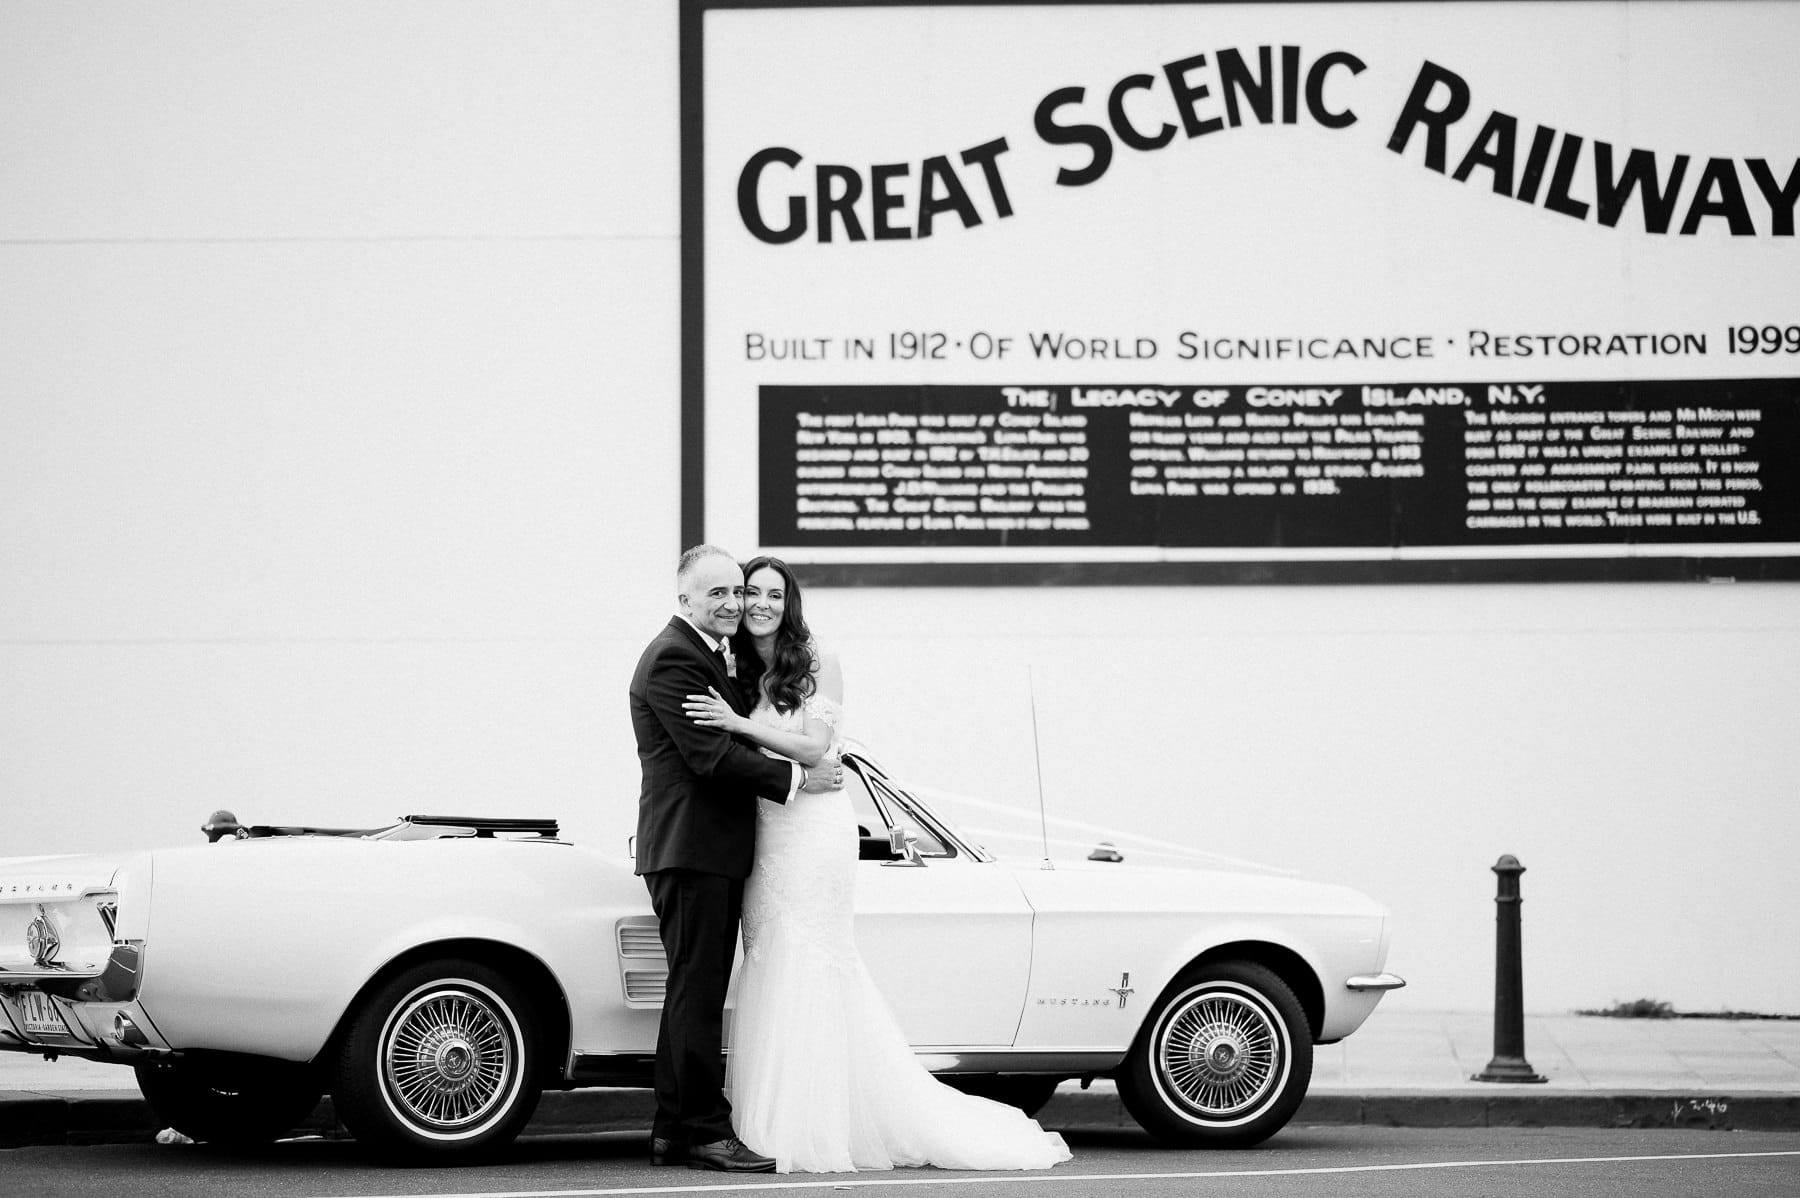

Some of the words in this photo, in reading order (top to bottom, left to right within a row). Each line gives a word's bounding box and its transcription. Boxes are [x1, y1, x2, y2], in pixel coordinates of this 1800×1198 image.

[737, 137, 1013, 244] GREAT
[1034, 46, 1367, 186] SCENIC
[1387, 60, 1800, 236] RAILWAY
[746, 334, 830, 360] BUILT
[846, 339, 873, 359] IN
[891, 332, 947, 359] 1912
[970, 332, 1012, 359] OF
[1029, 333, 1157, 359] WORLD
[1178, 332, 1433, 360] SIGNIFICANCE
[1469, 330, 1707, 357] RESTORATION
[1728, 324, 1800, 355] 1999
[1001, 388, 1049, 407] THE
[1070, 388, 1182, 407] LEGACY
[1191, 389, 1231, 407] OF
[1245, 387, 1343, 407] CONEY
[1361, 386, 1472, 406] ISLAND,
[1485, 385, 1545, 404] N.Y.
